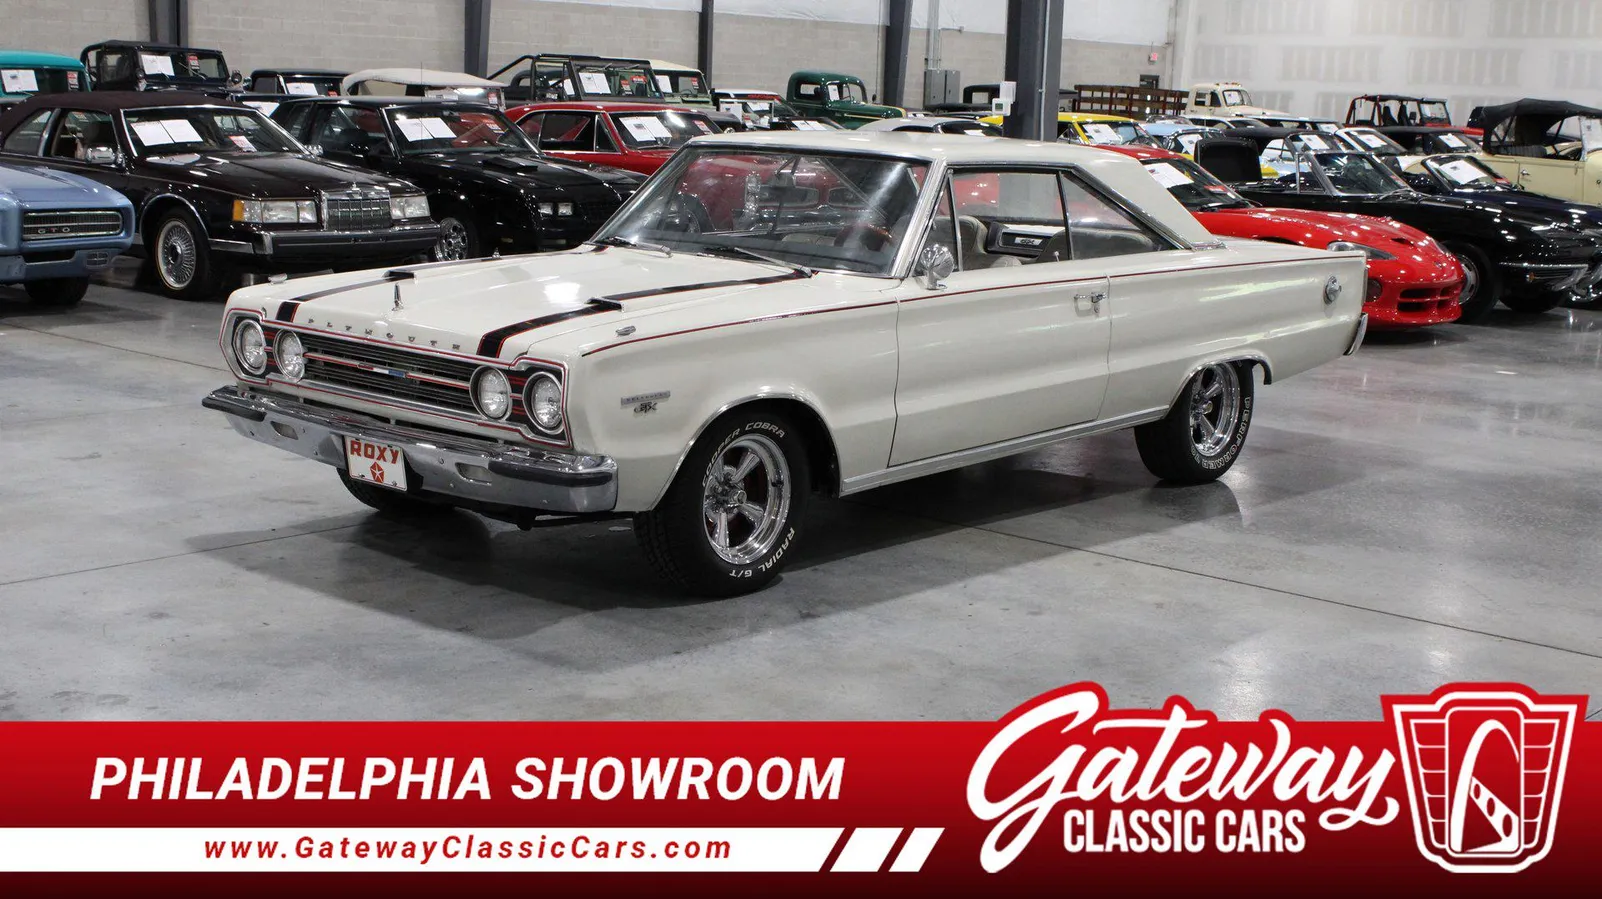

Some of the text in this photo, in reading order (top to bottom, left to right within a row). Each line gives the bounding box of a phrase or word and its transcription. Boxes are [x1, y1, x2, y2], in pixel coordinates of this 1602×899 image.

[37, 226, 71, 235] GTO
[307, 317, 461, 351] PLYMOUTH
[350, 440, 400, 465] ROXY
[702, 421, 786, 488] COOPER COBRA
[729, 527, 795, 578] RADIAL G/T
